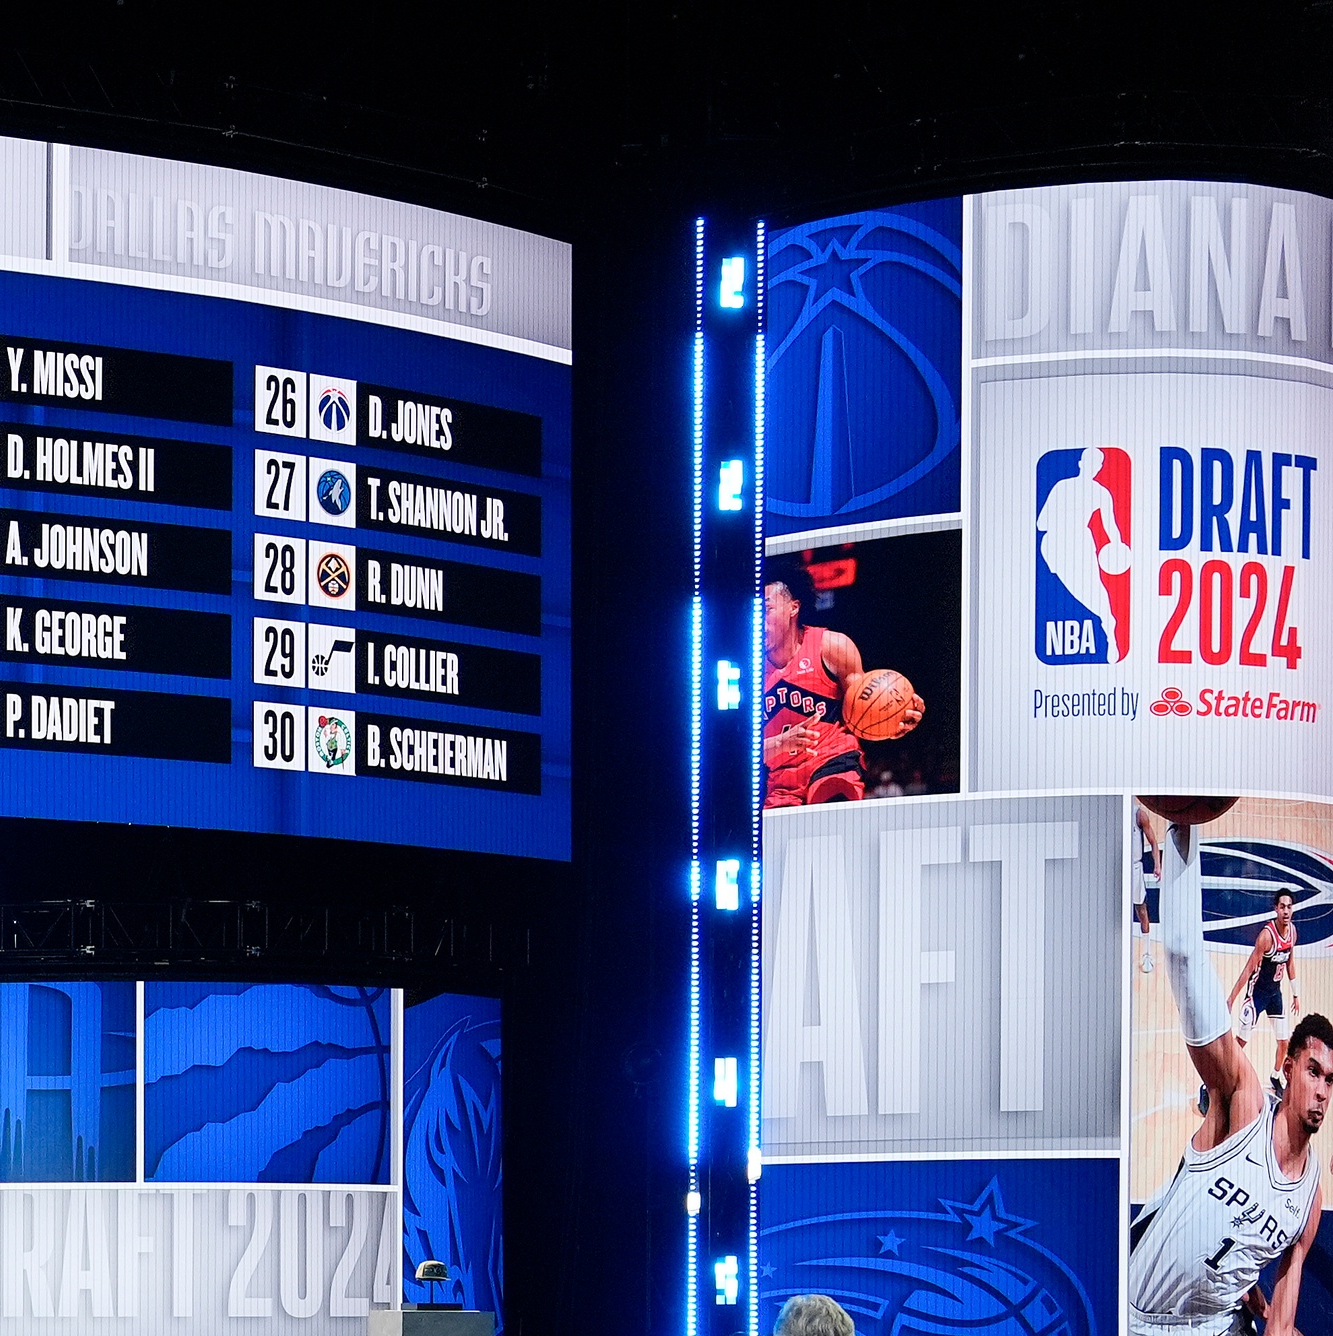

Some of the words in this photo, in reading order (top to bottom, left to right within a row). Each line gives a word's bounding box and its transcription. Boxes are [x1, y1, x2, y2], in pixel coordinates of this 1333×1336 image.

[70, 185, 234, 269] DALLAS
[255, 210, 491, 317] MAVERICKS
[986, 195, 1308, 343] DIANA
[7, 347, 27, 392] Y.
[34, 350, 102, 400] MISSI
[266, 375, 295, 428] 26
[369, 395, 387, 439] D.
[392, 400, 452, 450] JONES
[8, 434, 29, 479] D.
[37, 437, 133, 489] HOLMES
[139, 448, 154, 491] II
[266, 459, 295, 511] 27
[368, 478, 383, 521] T.
[388, 481, 476, 535] SHANNON
[481, 499, 508, 541] JR.
[1159, 445, 1317, 559] DRAFT
[6, 521, 28, 565] A.
[34, 524, 147, 576] JOHNSON
[265, 543, 294, 595] 28
[368, 560, 385, 603] R.
[391, 563, 443, 611] DUNN
[7, 607, 28, 652] K.
[35, 609, 126, 659] GEORGE
[1045, 620, 1096, 656] NBA
[1158, 558, 1302, 670] 2024
[265, 626, 294, 679] 29
[368, 642, 379, 684] I.
[384, 644, 459, 694] COLLIER
[7, 694, 24, 738] P.
[32, 696, 115, 744] DADIET
[1034, 687, 1117, 719] Presented
[1120, 687, 1139, 721] by
[1196, 688, 1264, 719] State
[1266, 691, 1318, 723] Farm
[264, 710, 294, 762] 30
[368, 725, 385, 767] B.
[390, 727, 506, 781] SCHEIERMAN
[1208, 1176, 1288, 1250] SPURS
[1202, 1237, 1237, 1273] 1
